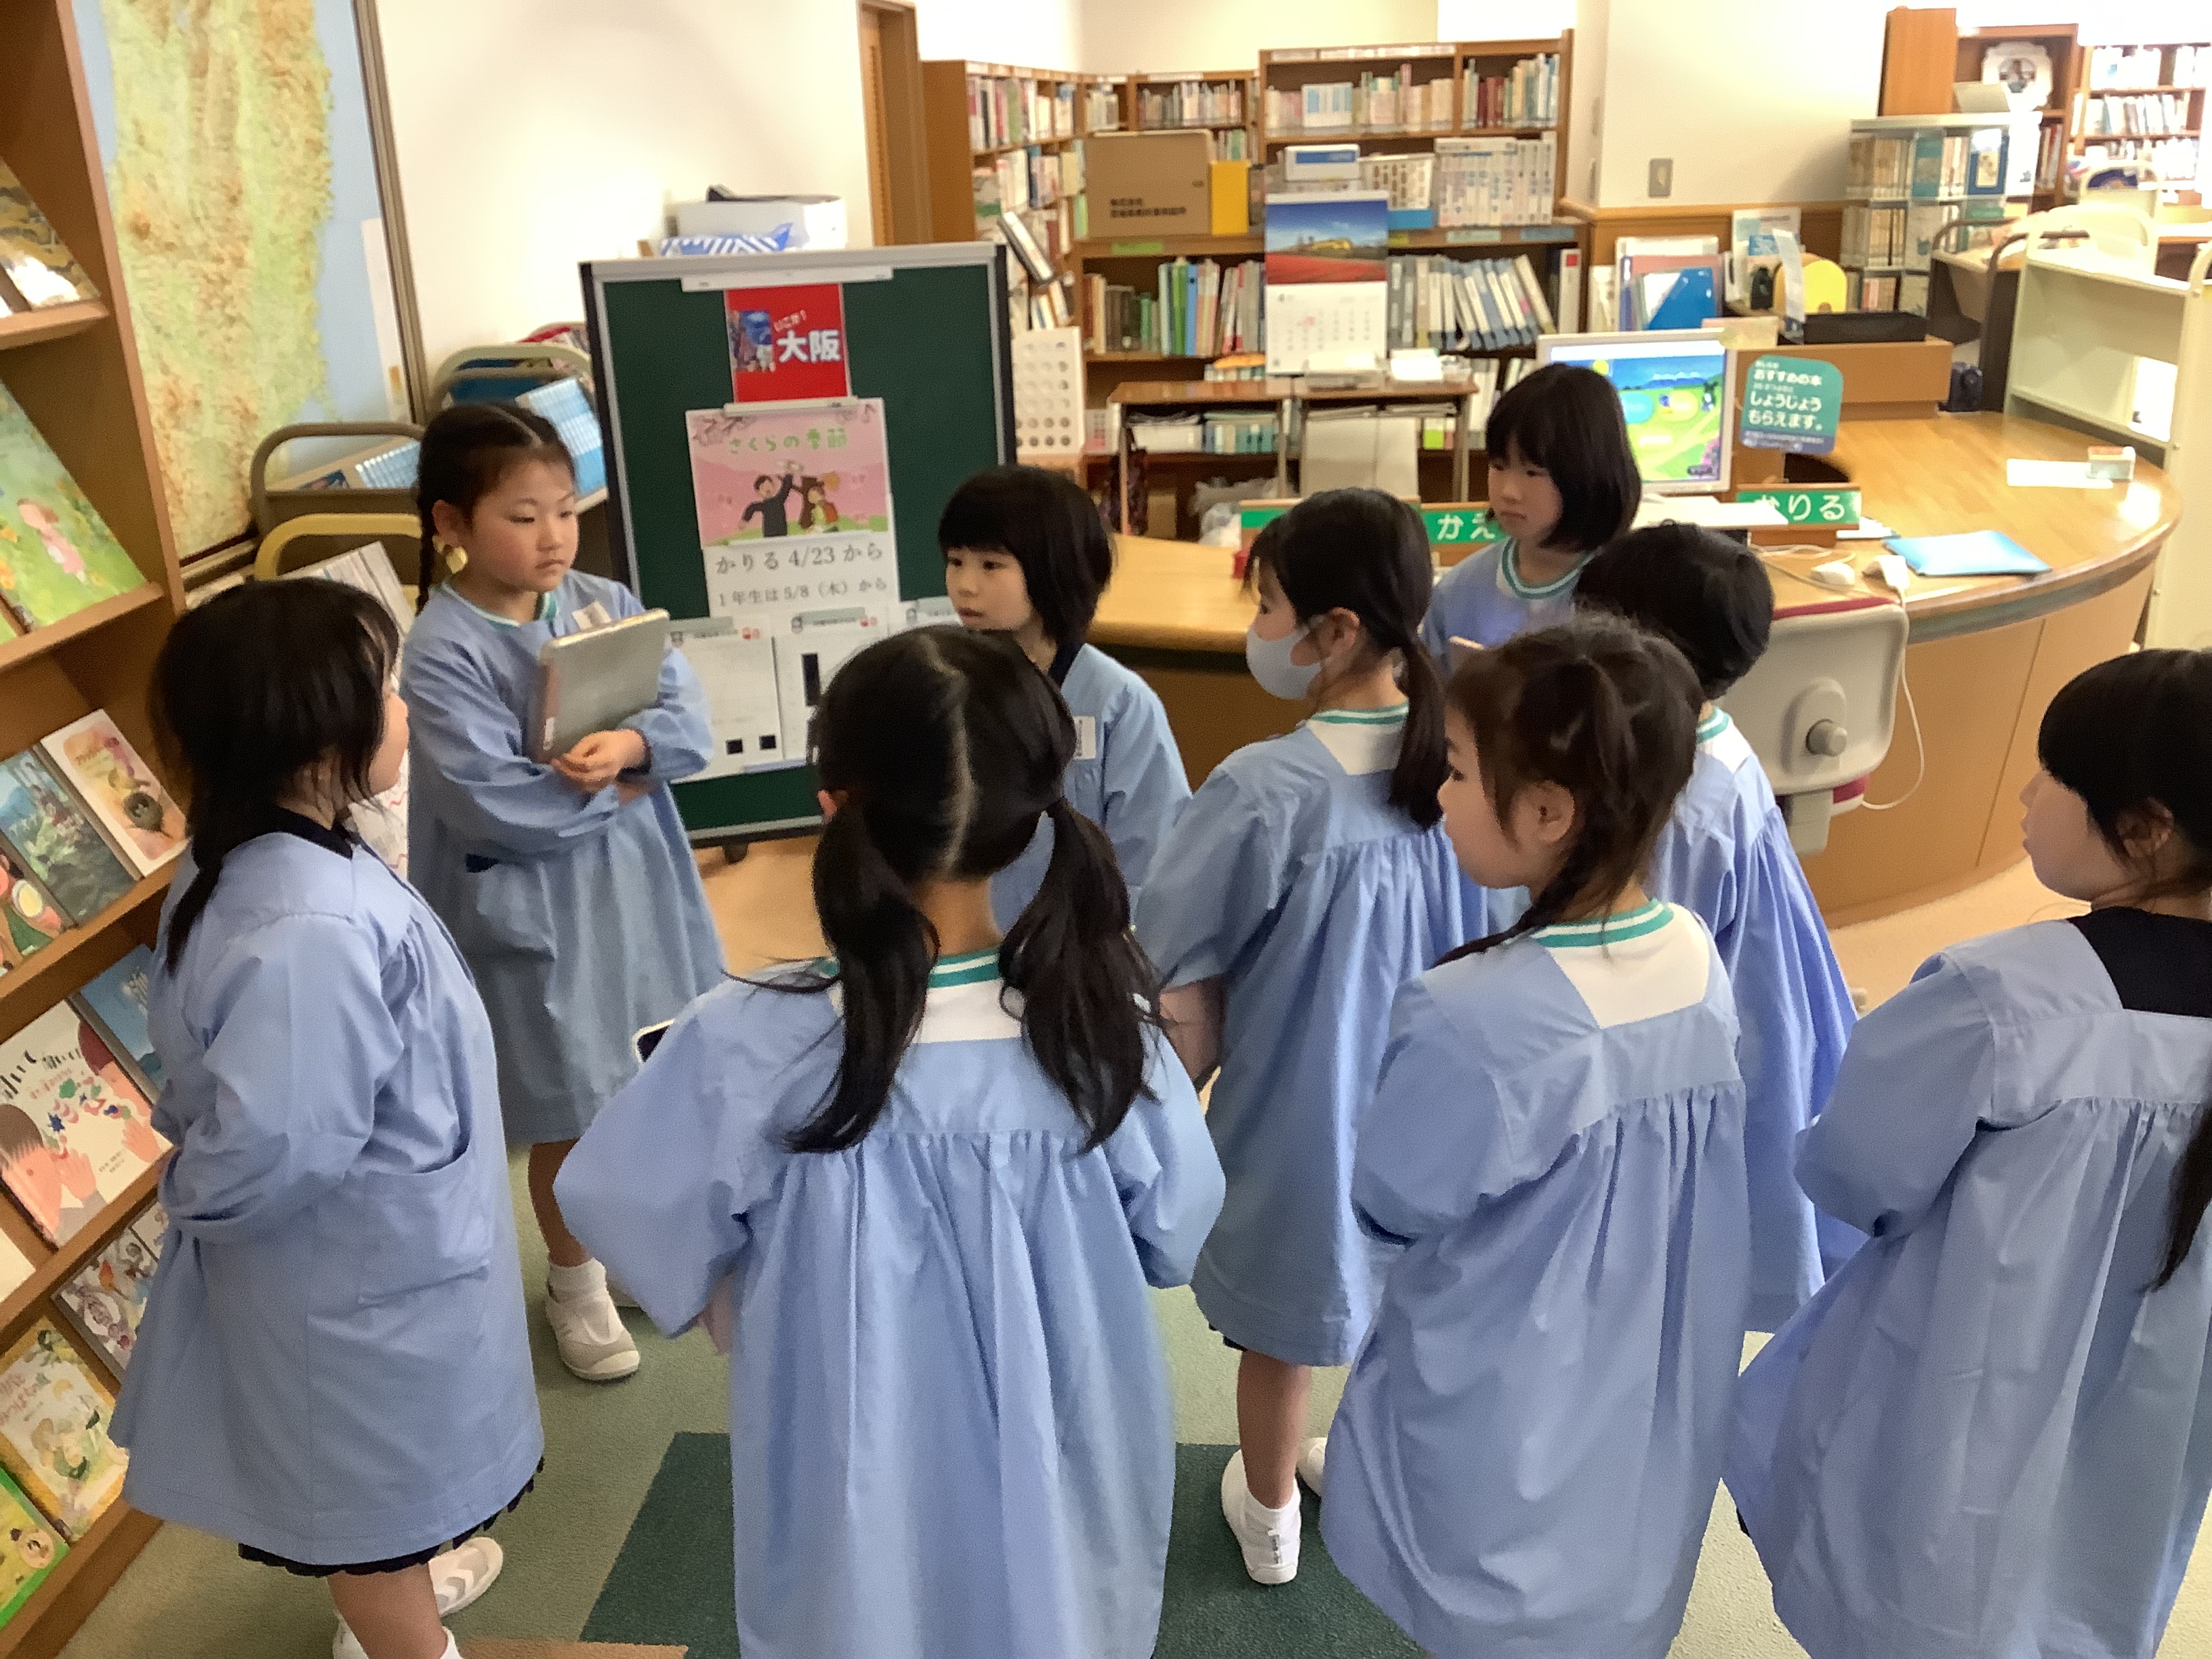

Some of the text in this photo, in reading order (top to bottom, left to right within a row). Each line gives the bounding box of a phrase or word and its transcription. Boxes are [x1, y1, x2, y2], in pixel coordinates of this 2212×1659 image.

[777, 329, 840, 363] 大阪
[1748, 409, 1822, 431] もらえます。
[729, 428, 848, 454] さくらの季節
[1437, 513, 1496, 540] かえ
